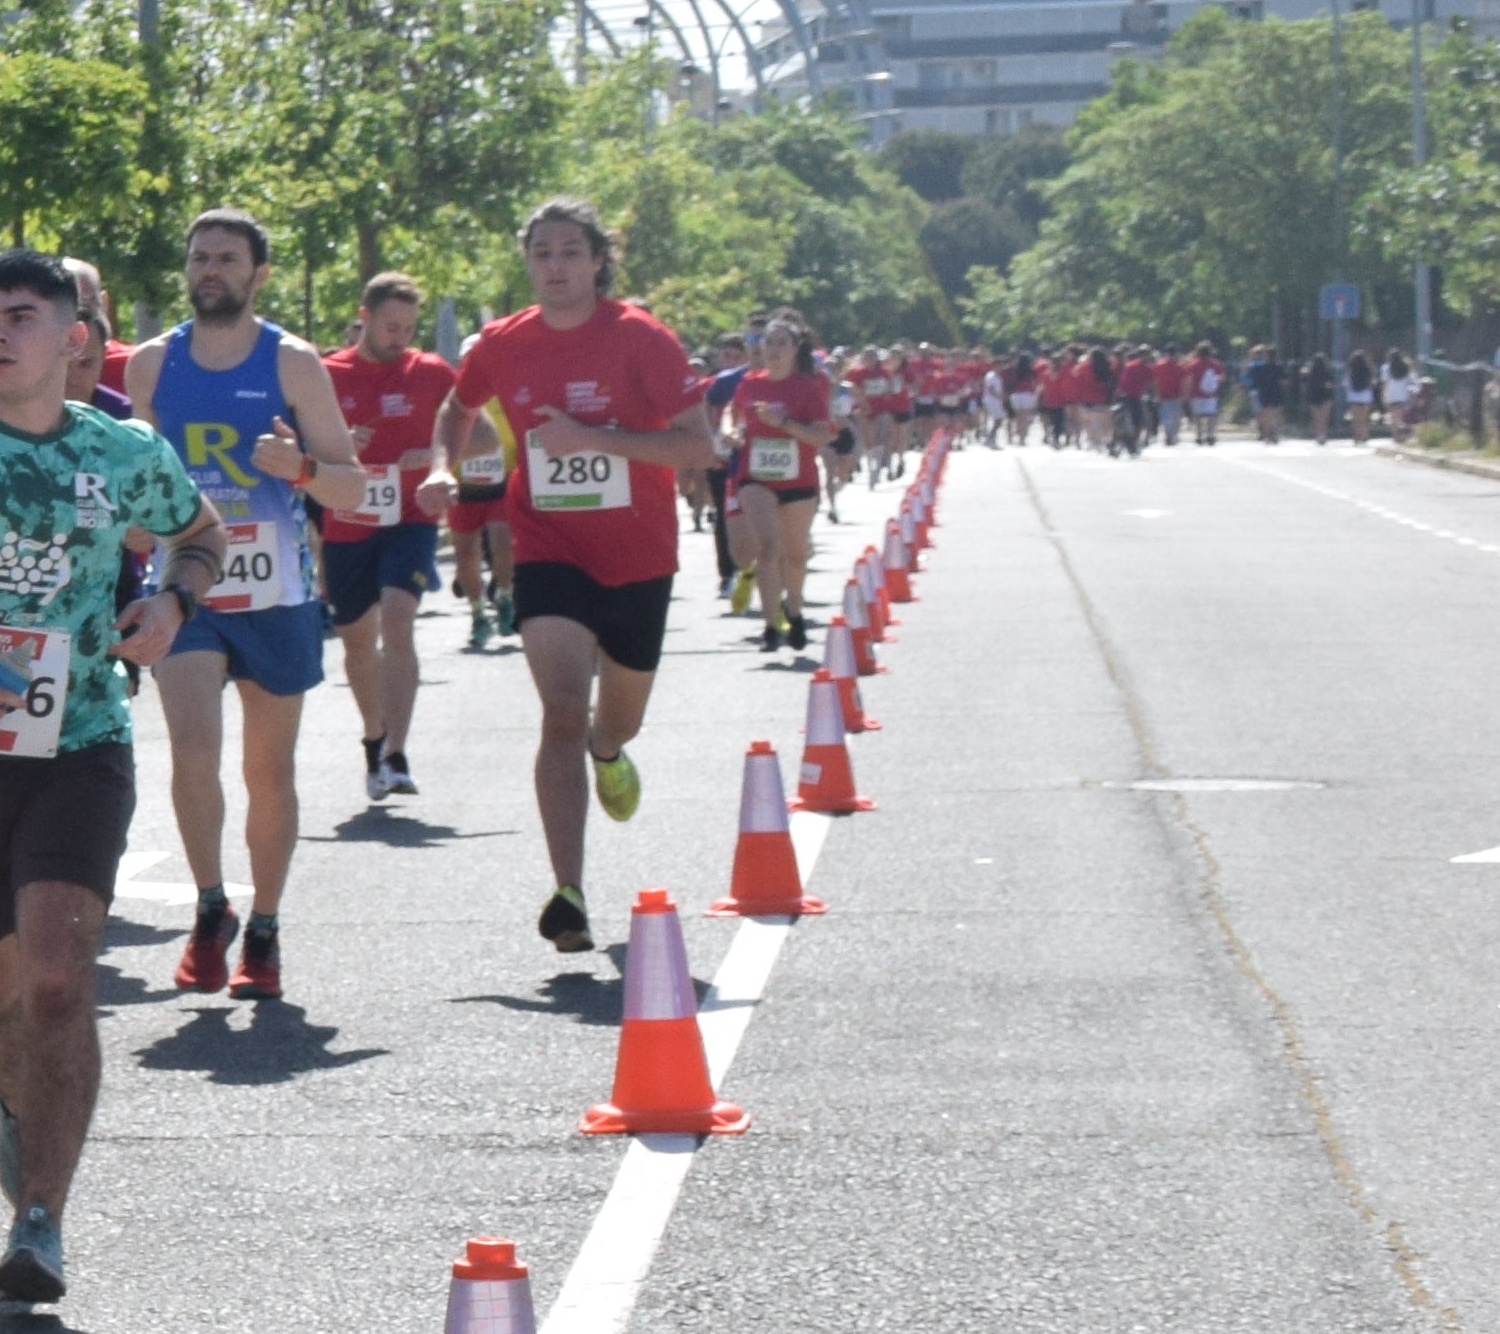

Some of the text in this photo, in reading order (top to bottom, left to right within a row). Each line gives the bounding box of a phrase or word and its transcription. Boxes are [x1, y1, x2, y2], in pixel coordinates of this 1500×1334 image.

[184, 423, 260, 488] R
[547, 455, 611, 485] 280
[758, 453, 791, 467] 360
